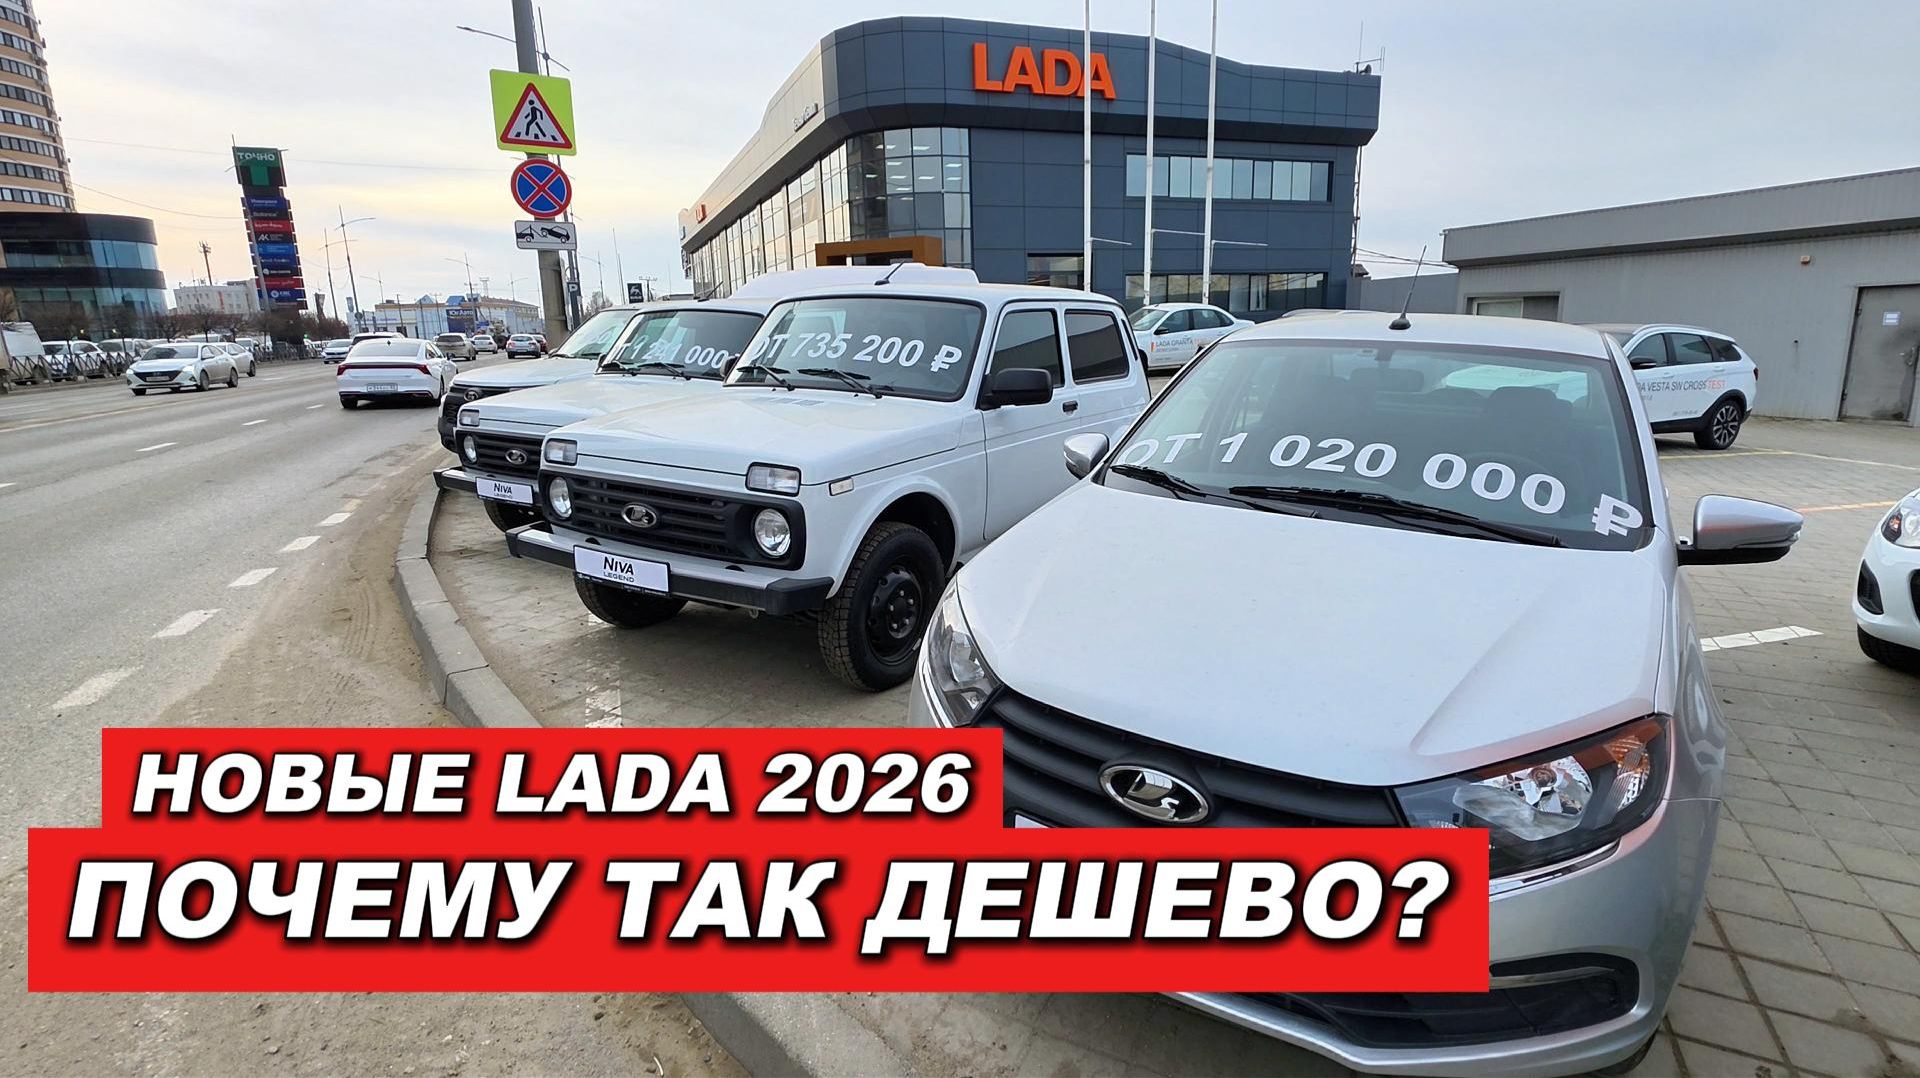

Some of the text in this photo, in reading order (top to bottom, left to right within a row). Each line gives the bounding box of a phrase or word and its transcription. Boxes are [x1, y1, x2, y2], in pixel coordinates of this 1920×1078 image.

[973, 42, 1117, 100] LADA
[684, 344, 730, 369] 000
[751, 332, 963, 373] ОТ 735 200 ₽
[1647, 381, 1670, 392] VESTA
[1683, 379, 1707, 390] CROSS
[1708, 379, 1726, 390] TEST
[1117, 431, 1644, 537] ОТ 1 020 000 ₽
[603, 571, 635, 583] LEGEND
